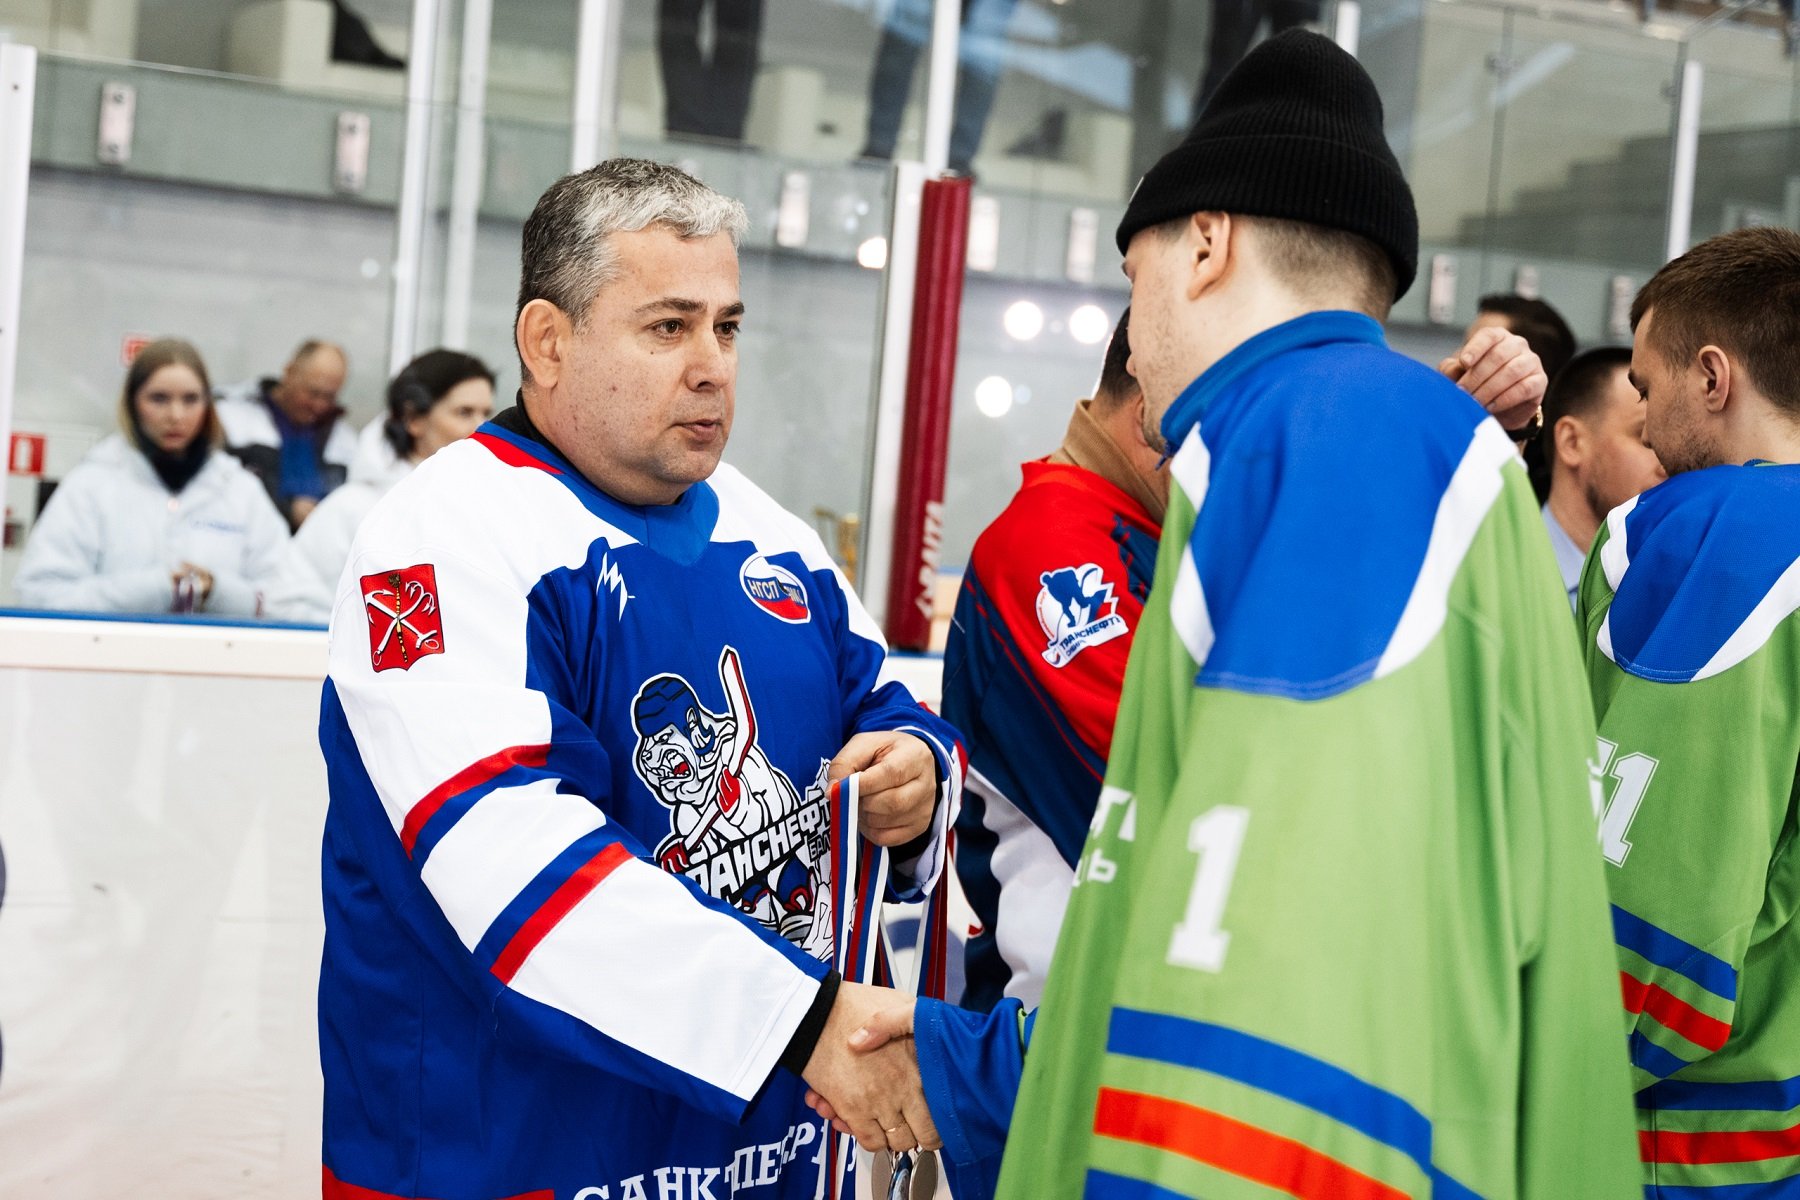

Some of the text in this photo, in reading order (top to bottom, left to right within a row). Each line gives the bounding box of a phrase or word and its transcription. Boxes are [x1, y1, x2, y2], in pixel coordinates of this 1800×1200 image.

[747, 579, 780, 600] НГСП
[809, 833, 831, 859] БАЛ
[1165, 803, 1251, 974] 1
